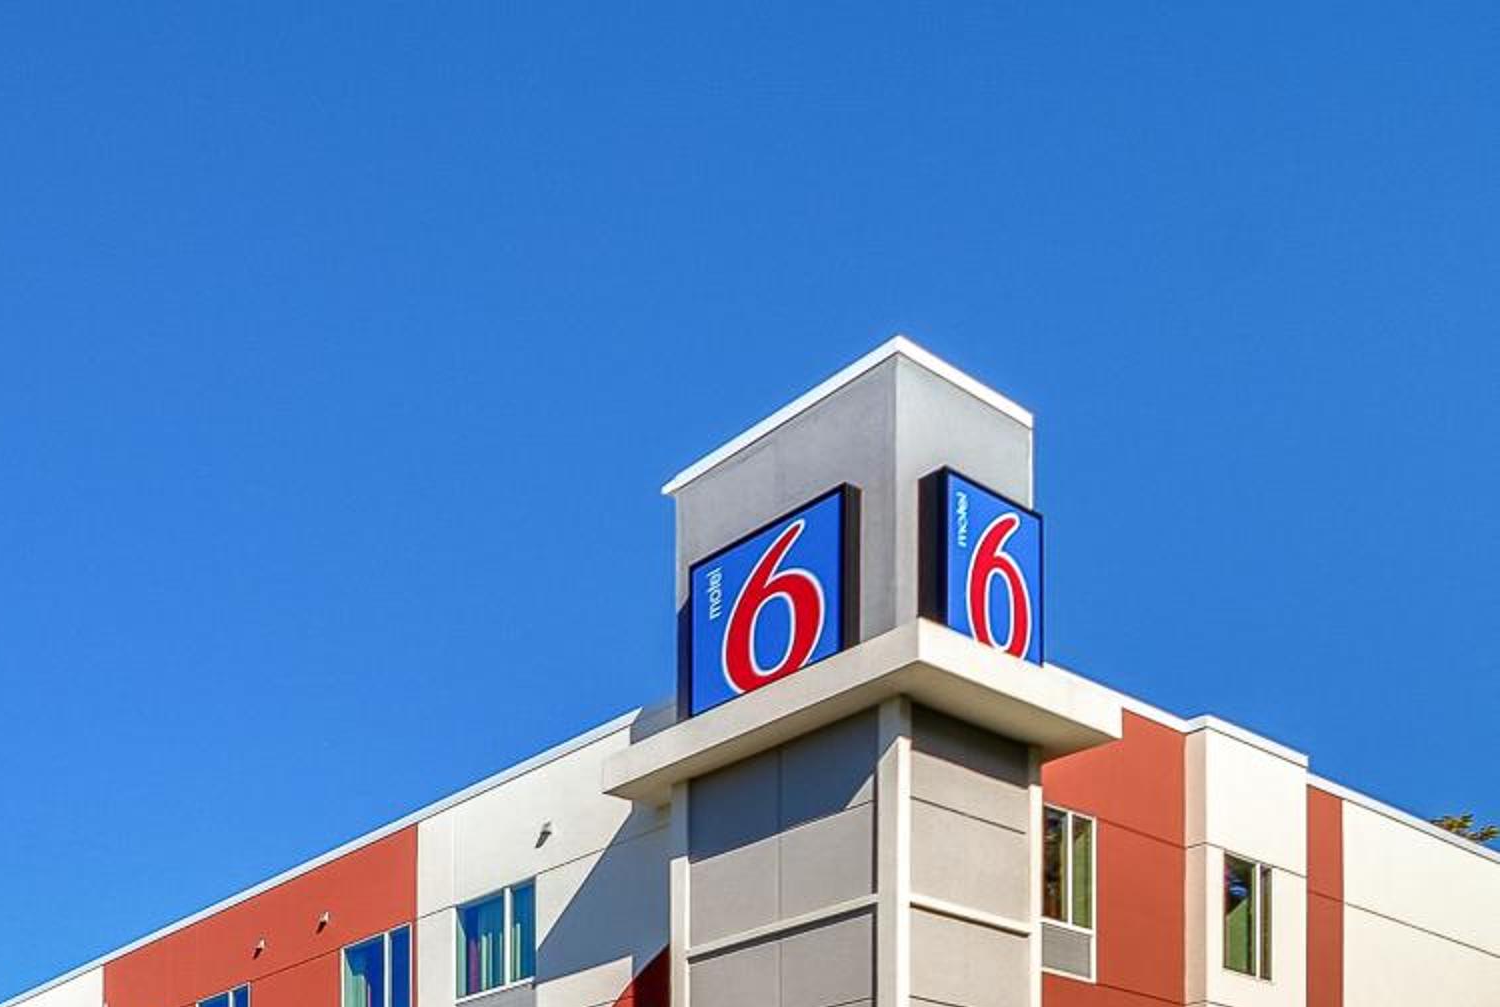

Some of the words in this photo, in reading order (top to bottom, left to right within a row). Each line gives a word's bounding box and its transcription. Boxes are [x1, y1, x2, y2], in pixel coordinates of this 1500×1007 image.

[956, 491, 968, 547] motel
[707, 566, 722, 620] motel
[722, 518, 825, 694] 6
[966, 512, 1032, 661] 6
